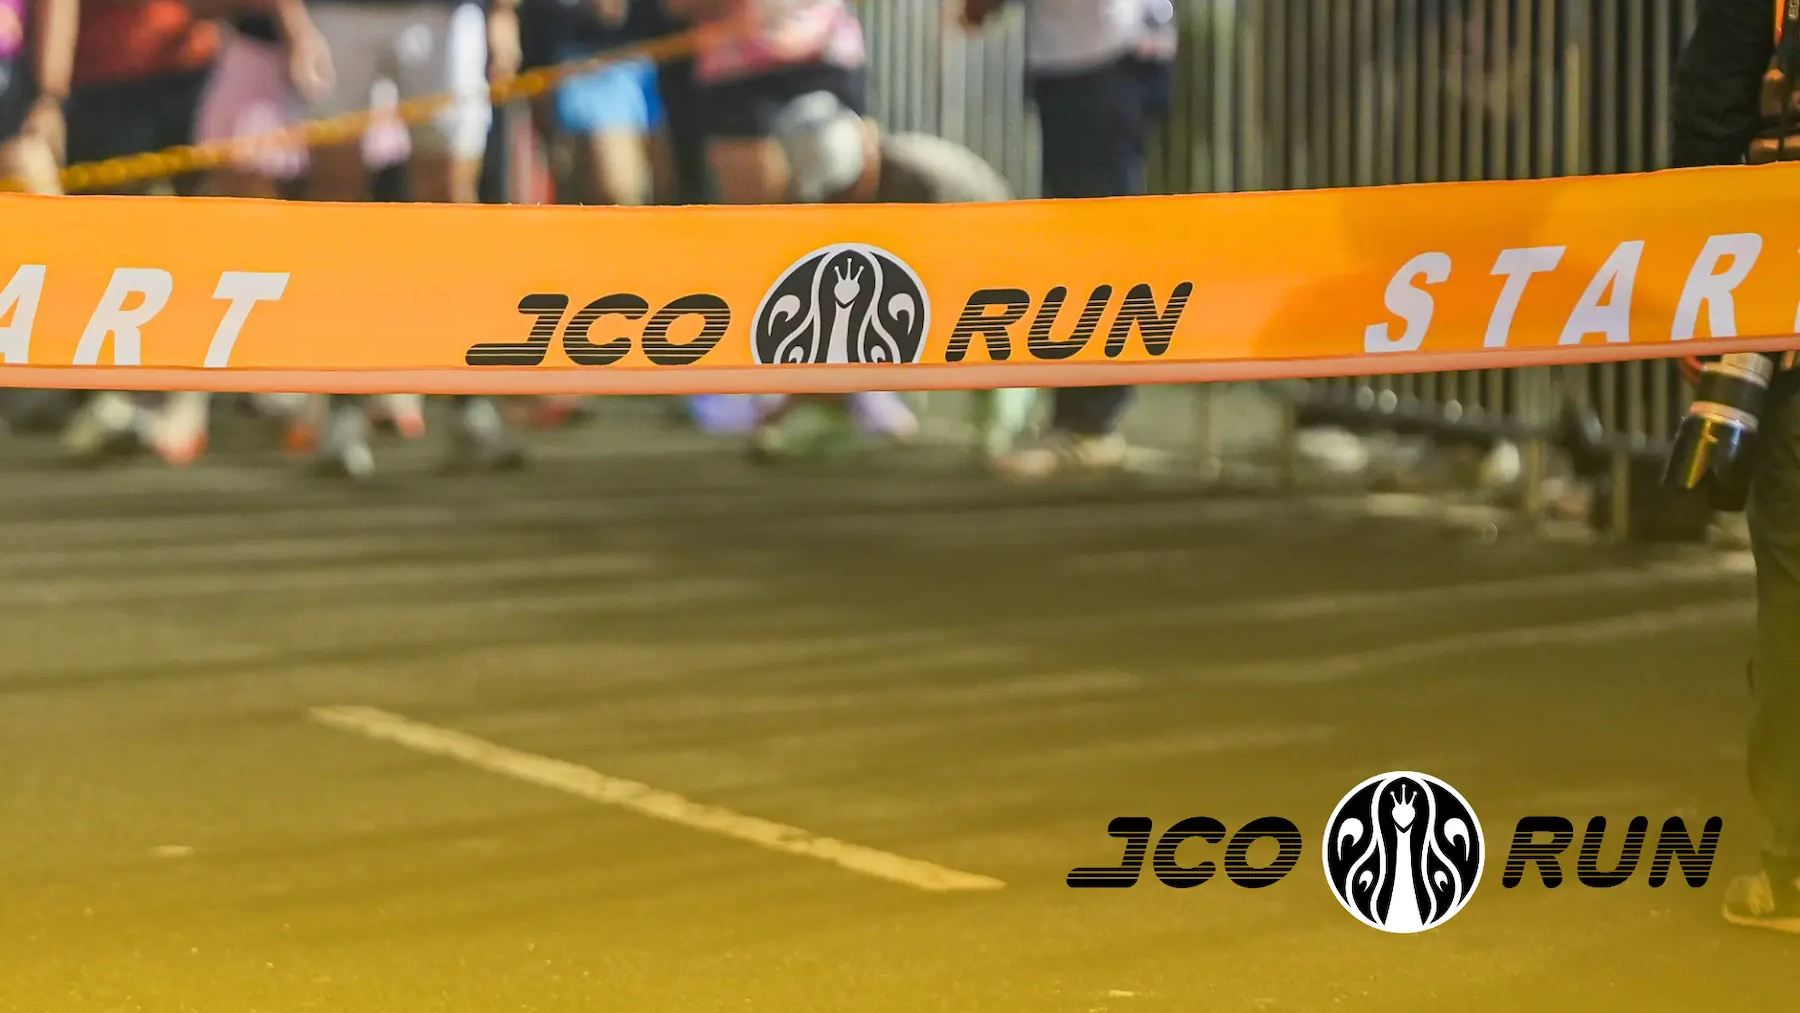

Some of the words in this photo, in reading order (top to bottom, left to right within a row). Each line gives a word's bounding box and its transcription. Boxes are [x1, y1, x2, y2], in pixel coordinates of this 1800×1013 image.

[465, 293, 730, 366] JCO
[945, 281, 1193, 362] RUN
[1364, 232, 1800, 353] STAR
